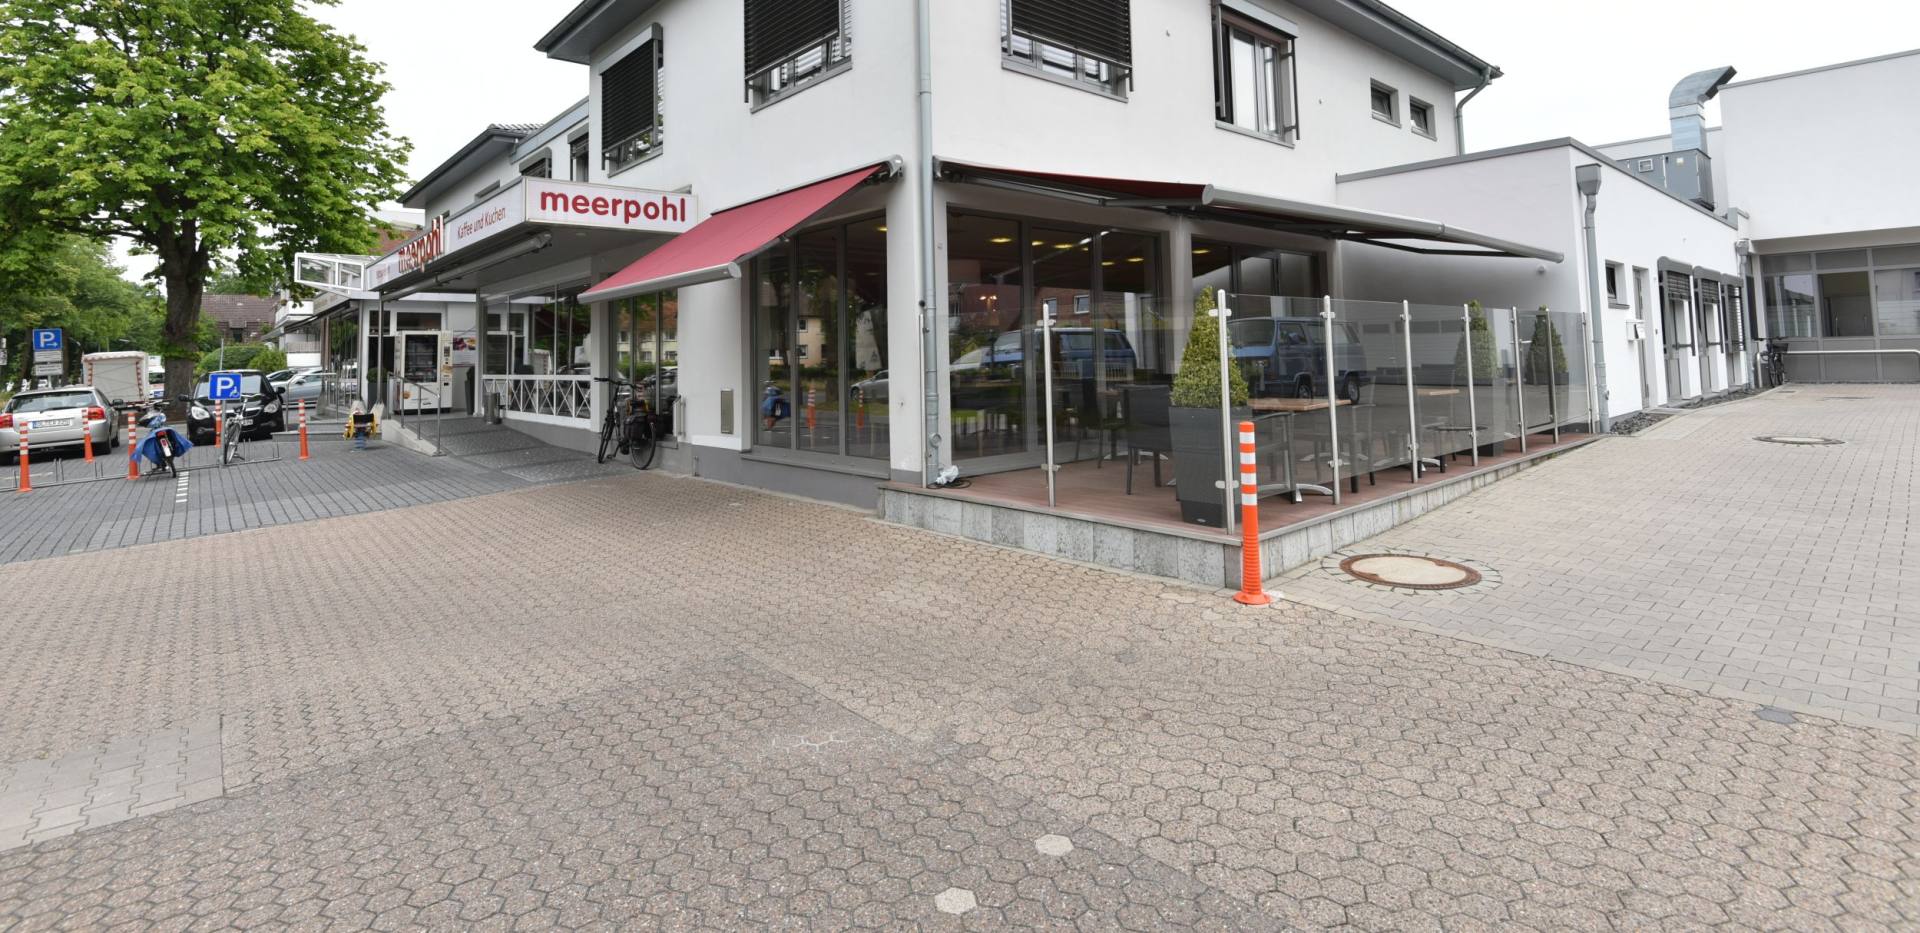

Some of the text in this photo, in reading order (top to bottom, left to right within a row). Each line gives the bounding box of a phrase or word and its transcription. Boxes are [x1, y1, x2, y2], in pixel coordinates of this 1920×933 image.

[457, 207, 506, 240] Kaffee und Kuchen
[540, 191, 686, 224] meerpohl
[398, 214, 445, 273] meerpohl
[40, 331, 55, 348] P
[216, 377, 234, 397] P
